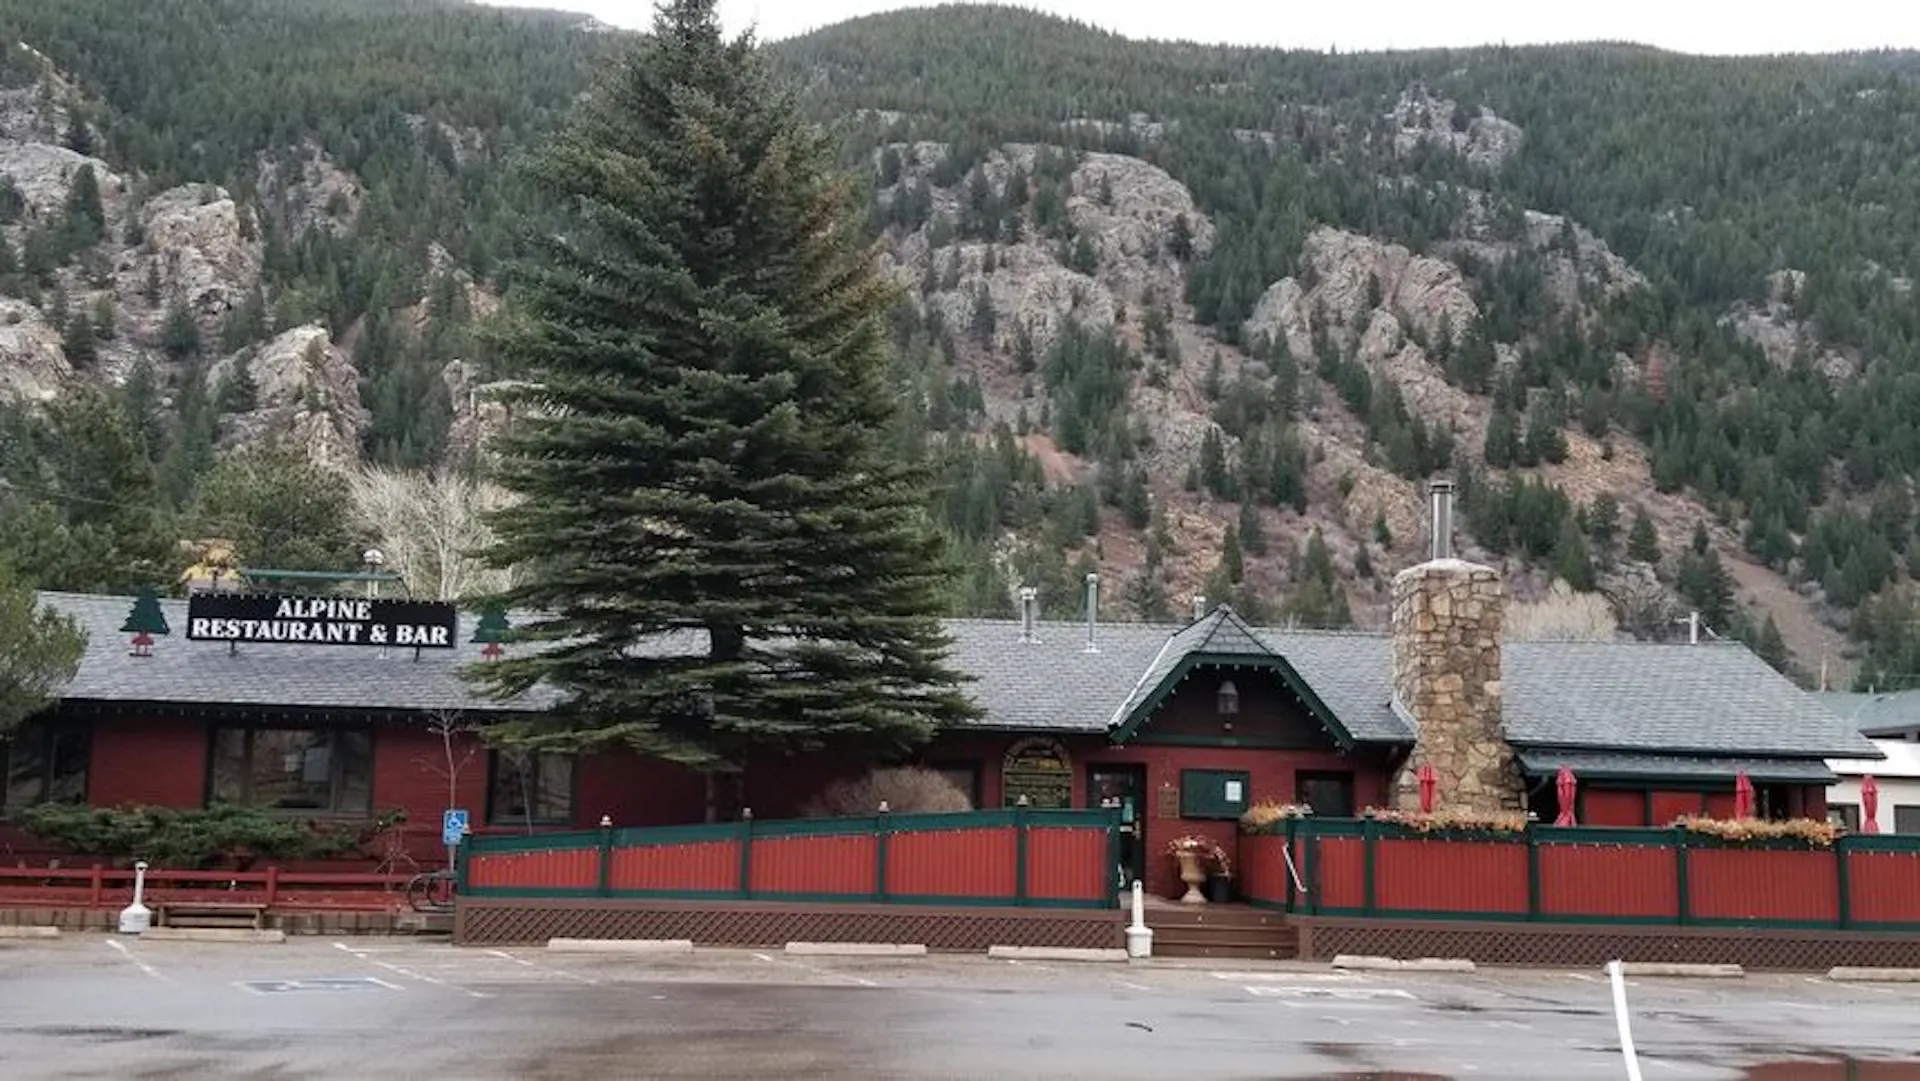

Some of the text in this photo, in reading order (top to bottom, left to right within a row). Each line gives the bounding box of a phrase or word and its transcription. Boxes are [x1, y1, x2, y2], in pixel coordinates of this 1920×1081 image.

[276, 599, 371, 619] ALPINE
[192, 618, 448, 644] RESTAURANT & BAR
